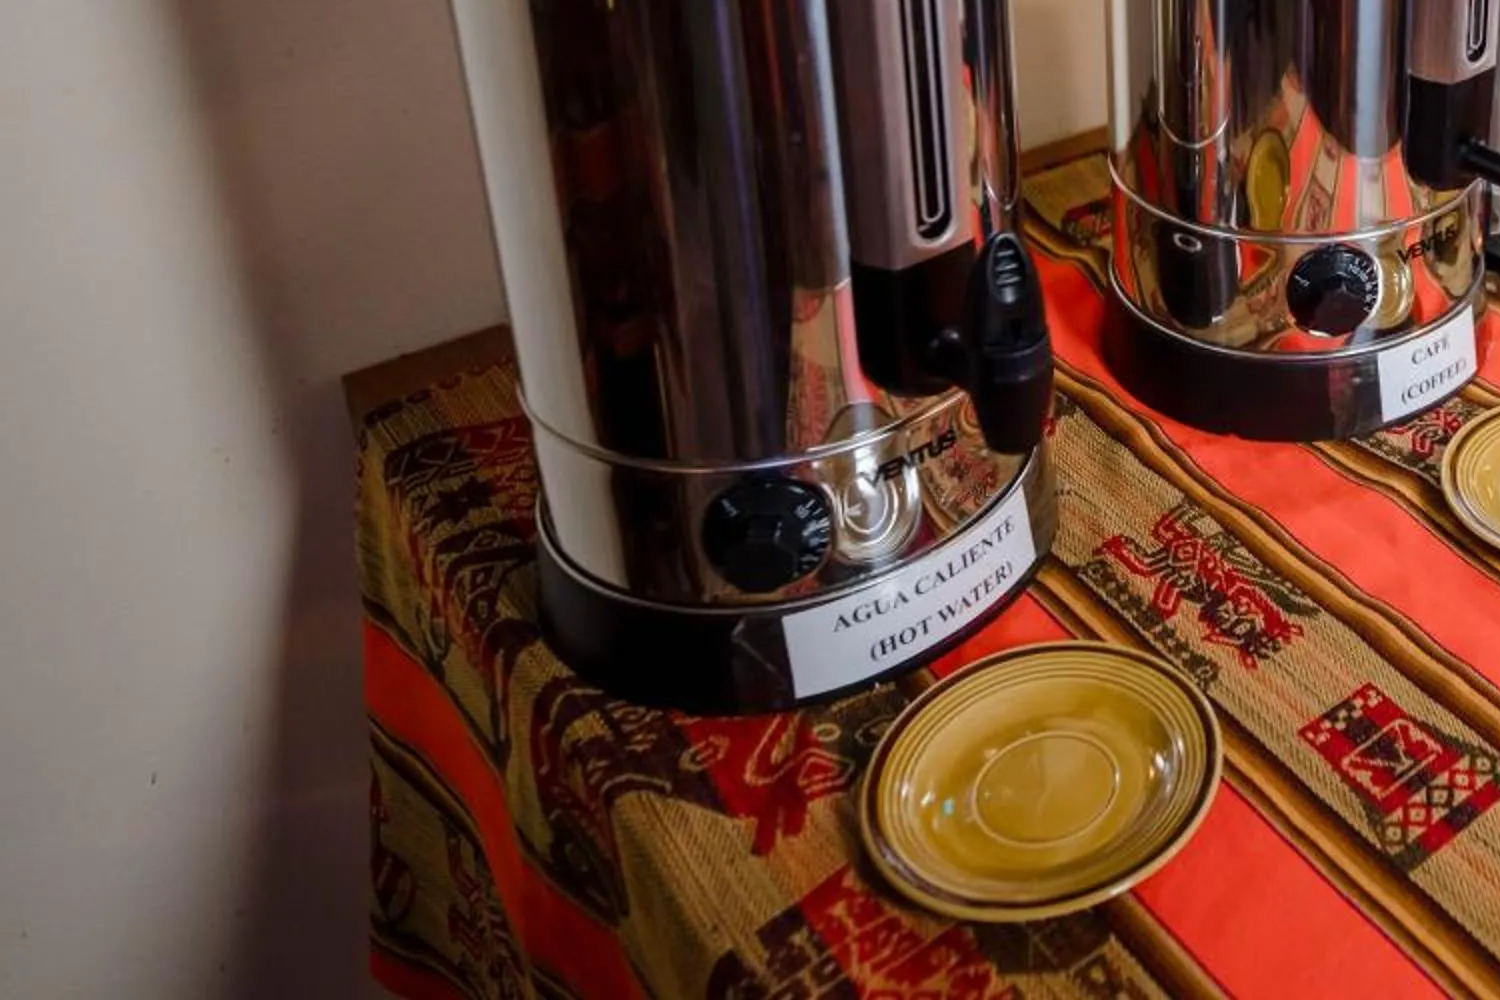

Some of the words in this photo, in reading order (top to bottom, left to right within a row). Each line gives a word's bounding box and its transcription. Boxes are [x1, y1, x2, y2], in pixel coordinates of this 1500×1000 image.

[858, 429, 957, 488] VENTUS
[832, 586, 910, 633] AGUA
[914, 517, 1016, 598] CALIENTE
[869, 617, 935, 663] (HOT
[938, 561, 1015, 624] WATER)
